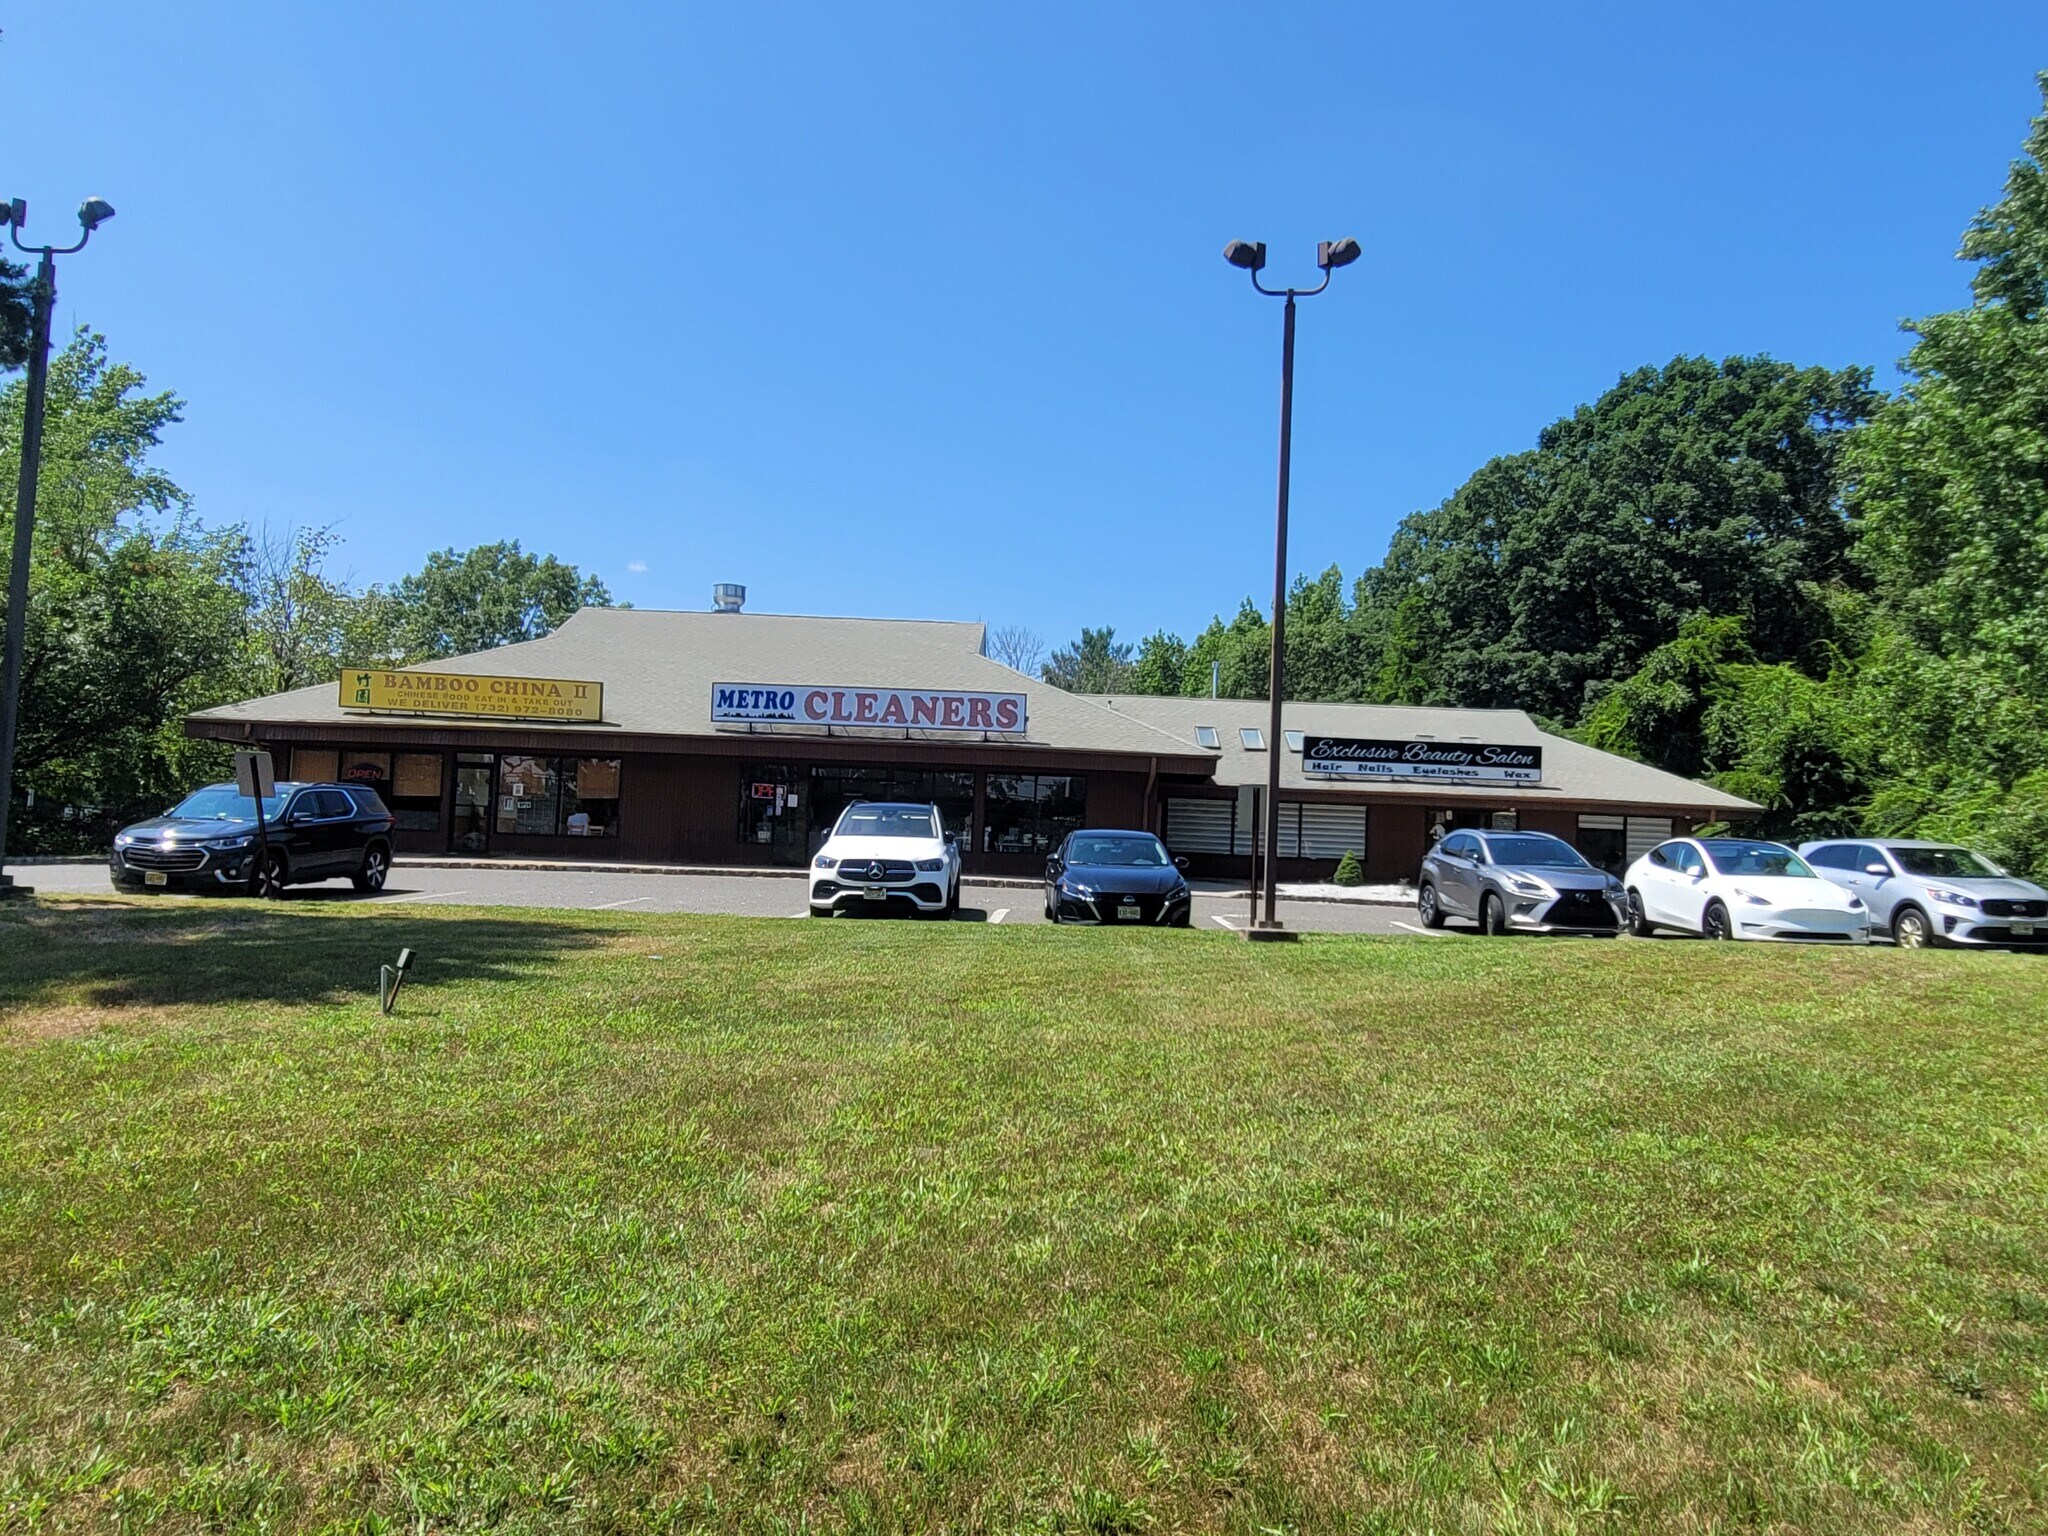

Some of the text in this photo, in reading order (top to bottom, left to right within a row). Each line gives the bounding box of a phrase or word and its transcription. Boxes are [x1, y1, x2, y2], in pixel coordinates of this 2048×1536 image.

[383, 674, 588, 699] BAMBOO CHINA II
[387, 698, 408, 707] WE
[413, 700, 468, 710] DELIVER
[476, 703, 509, 713] (732)
[397, 690, 439, 699] CHINESE
[443, 692, 470, 701] FOOD
[523, 698, 549, 706] TAKE
[553, 699, 573, 707] OUT
[716, 689, 1019, 729] METRO CLEANERS
[1310, 739, 1535, 766] Exclusive Beauty Salon
[347, 769, 382, 780] OPEN
[1312, 762, 1531, 779] Hair Nails Eyelashes Wax
